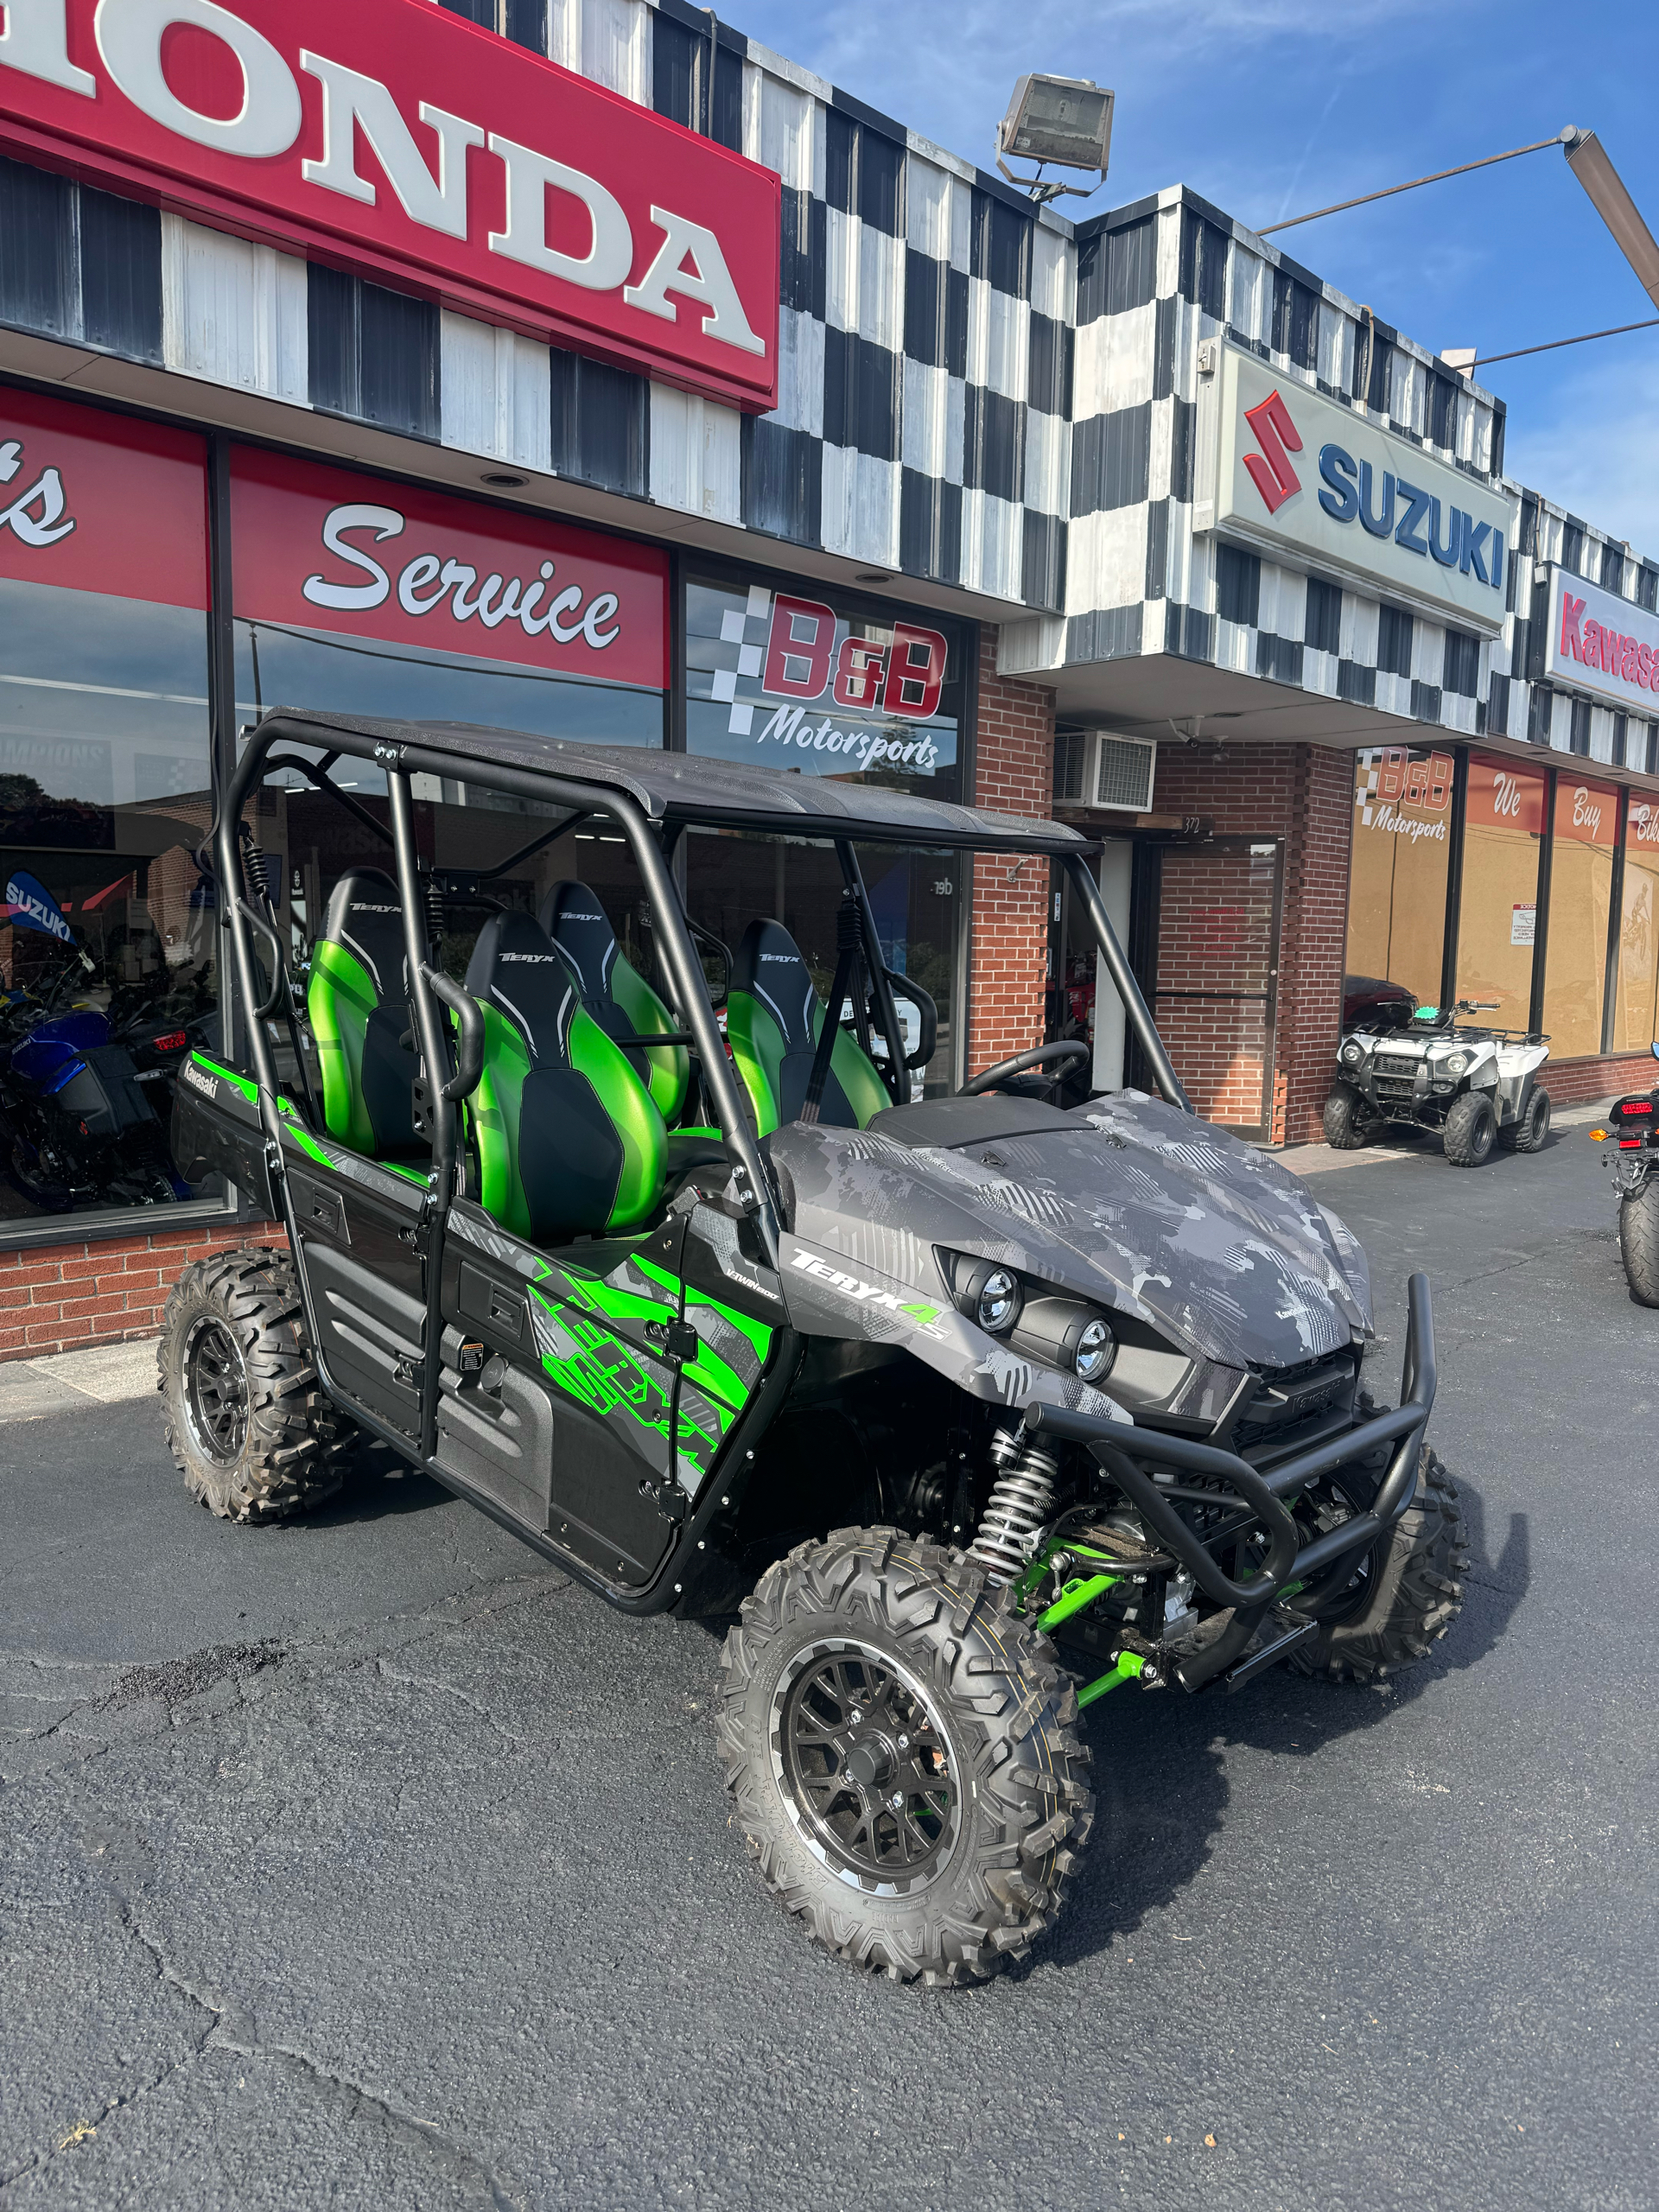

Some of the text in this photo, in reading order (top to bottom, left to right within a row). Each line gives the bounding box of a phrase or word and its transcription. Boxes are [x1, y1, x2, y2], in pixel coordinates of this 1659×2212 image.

[1318, 442, 1504, 590] SUZUKI
[302, 501, 620, 648] Service
[762, 592, 948, 720] B&B
[0, 739, 105, 769] MPIONS
[757, 703, 938, 771] Motorsports
[1376, 744, 1454, 811] B&B
[1184, 817, 1200, 834] 372
[1371, 805, 1446, 843] Motorsports
[1493, 772, 1520, 817] We
[1573, 786, 1600, 840] Buy
[6, 881, 71, 942] SUZUKI
[558, 912, 603, 921] TERYX
[499, 952, 556, 963] TERYX
[759, 953, 800, 963] TERYX
[184, 1059, 219, 1099] Kawasaki
